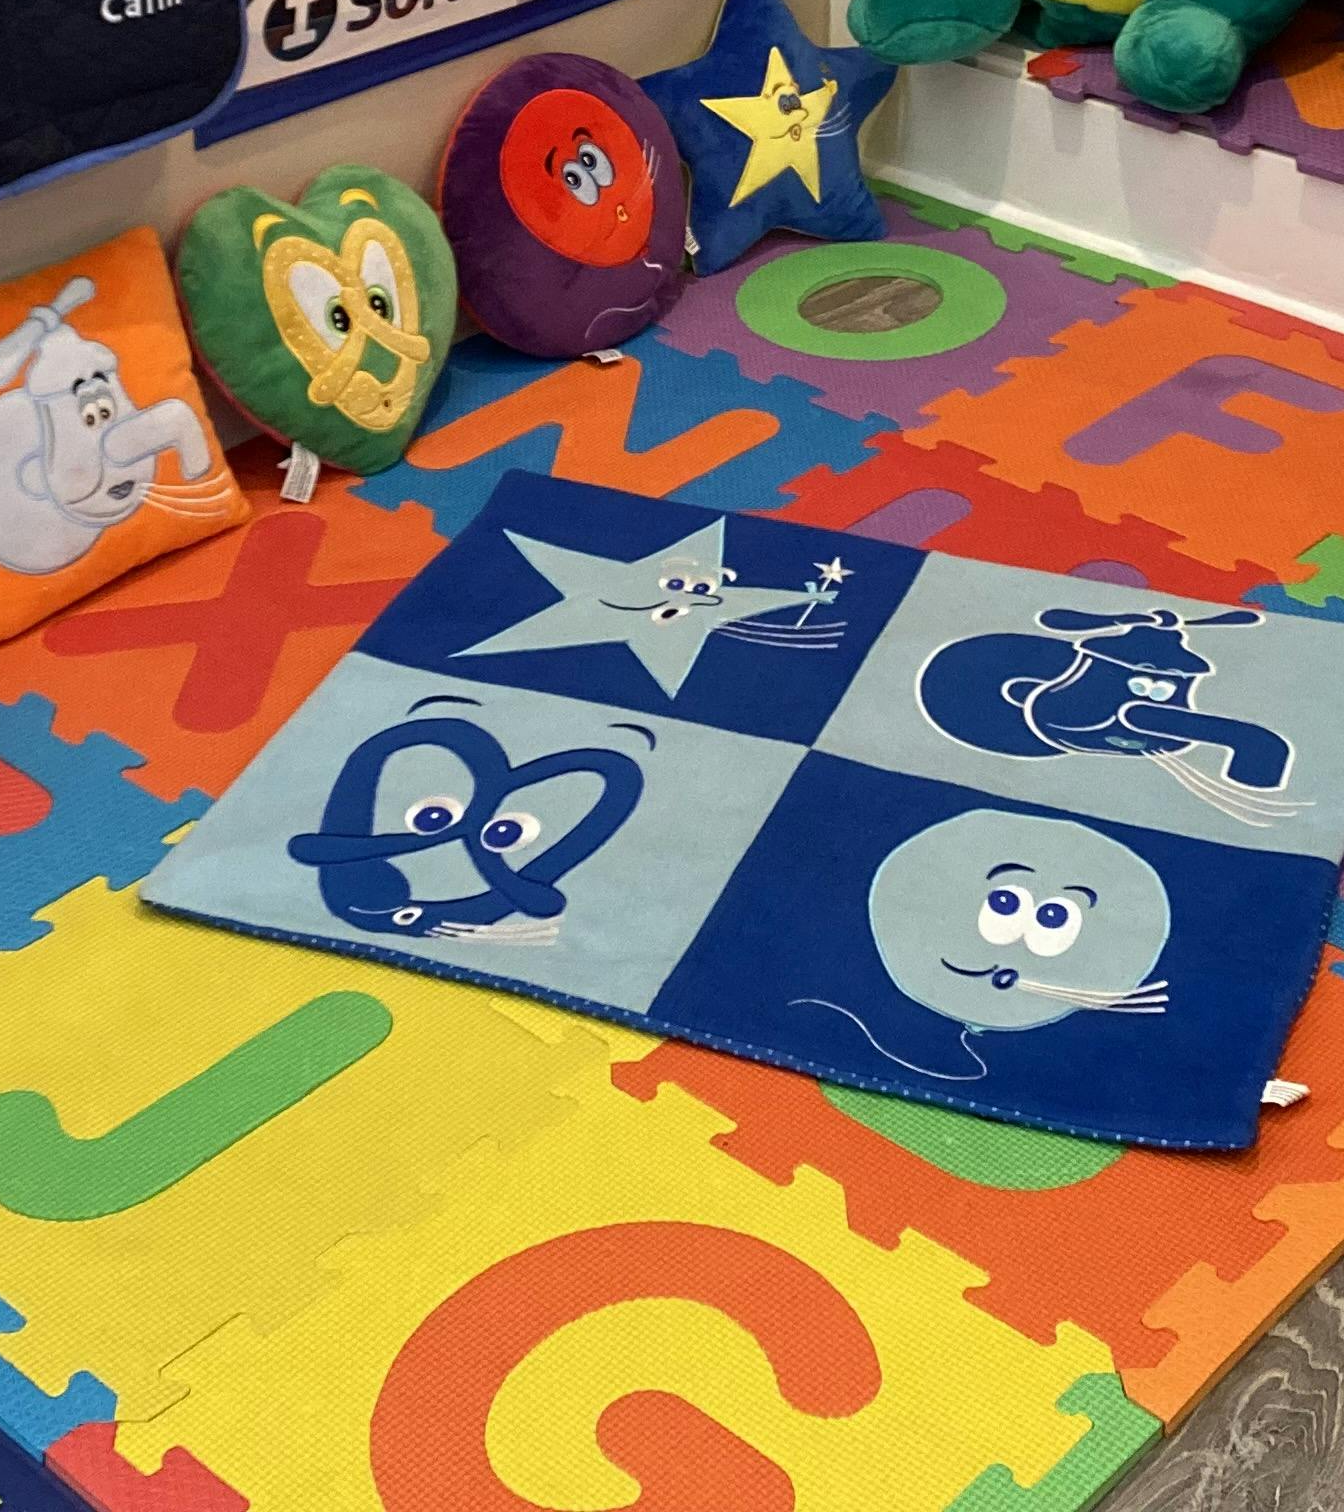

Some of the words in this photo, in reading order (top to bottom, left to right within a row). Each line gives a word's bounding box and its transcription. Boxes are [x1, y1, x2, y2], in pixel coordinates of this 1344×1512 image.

[735, 241, 1007, 361] O
[43, 510, 413, 734] X
[369, 1220, 883, 1512] G
